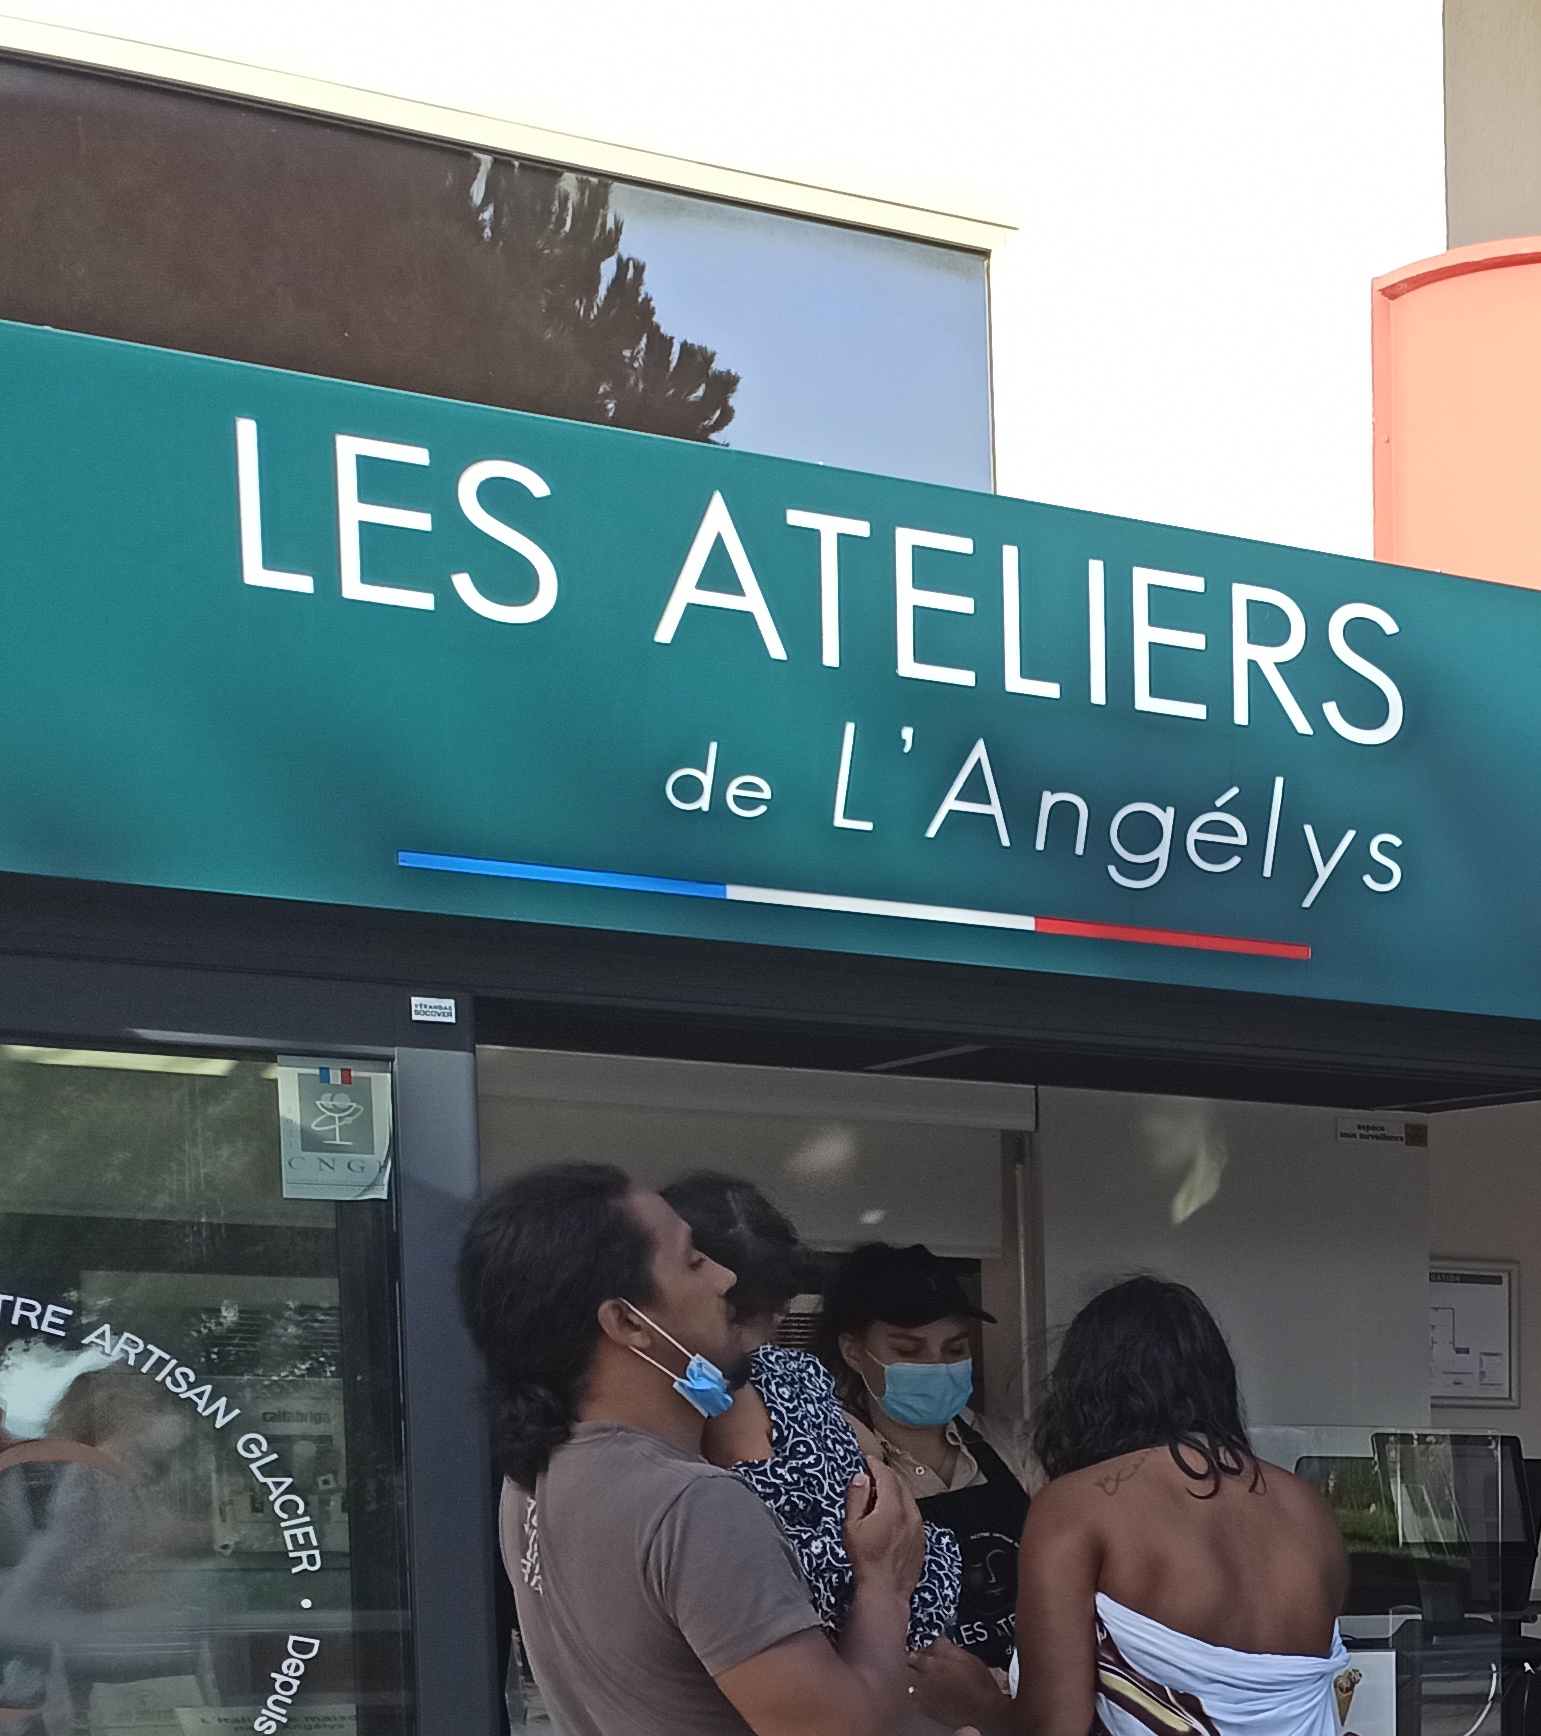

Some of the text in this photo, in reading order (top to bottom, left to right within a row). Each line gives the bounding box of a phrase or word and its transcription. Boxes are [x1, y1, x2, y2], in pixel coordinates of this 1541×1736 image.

[234, 417, 1405, 745] LES ATELIERS
[664, 722, 1402, 908] de L'Angélys
[81, 1323, 241, 1429] ARTISAN
[236, 1432, 322, 1574] GLACIER
[253, 1634, 321, 1735] Depuis
